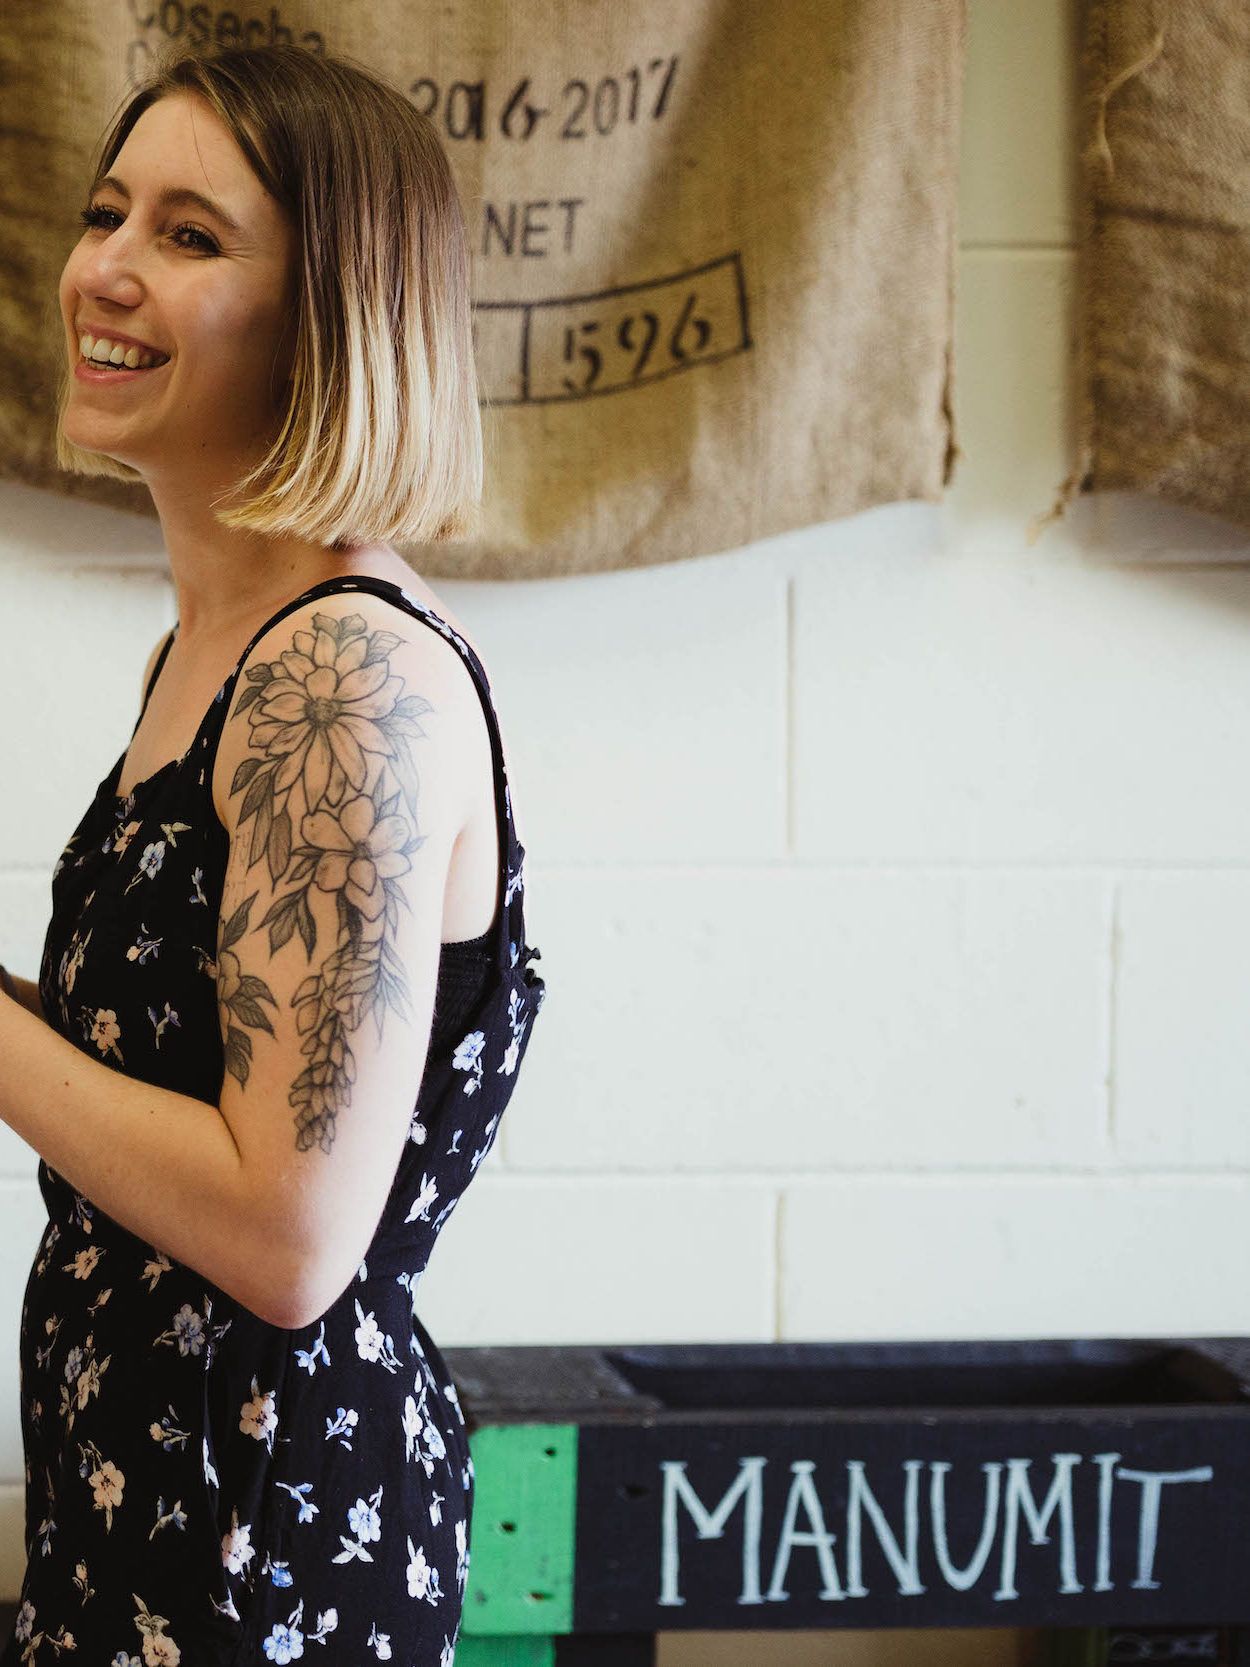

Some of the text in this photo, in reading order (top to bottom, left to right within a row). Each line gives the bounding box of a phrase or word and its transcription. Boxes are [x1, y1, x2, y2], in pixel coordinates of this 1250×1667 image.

[480, 198, 586, 257] NET
[562, 292, 712, 393] 596
[660, 1453, 1213, 1606] MANUMIT
